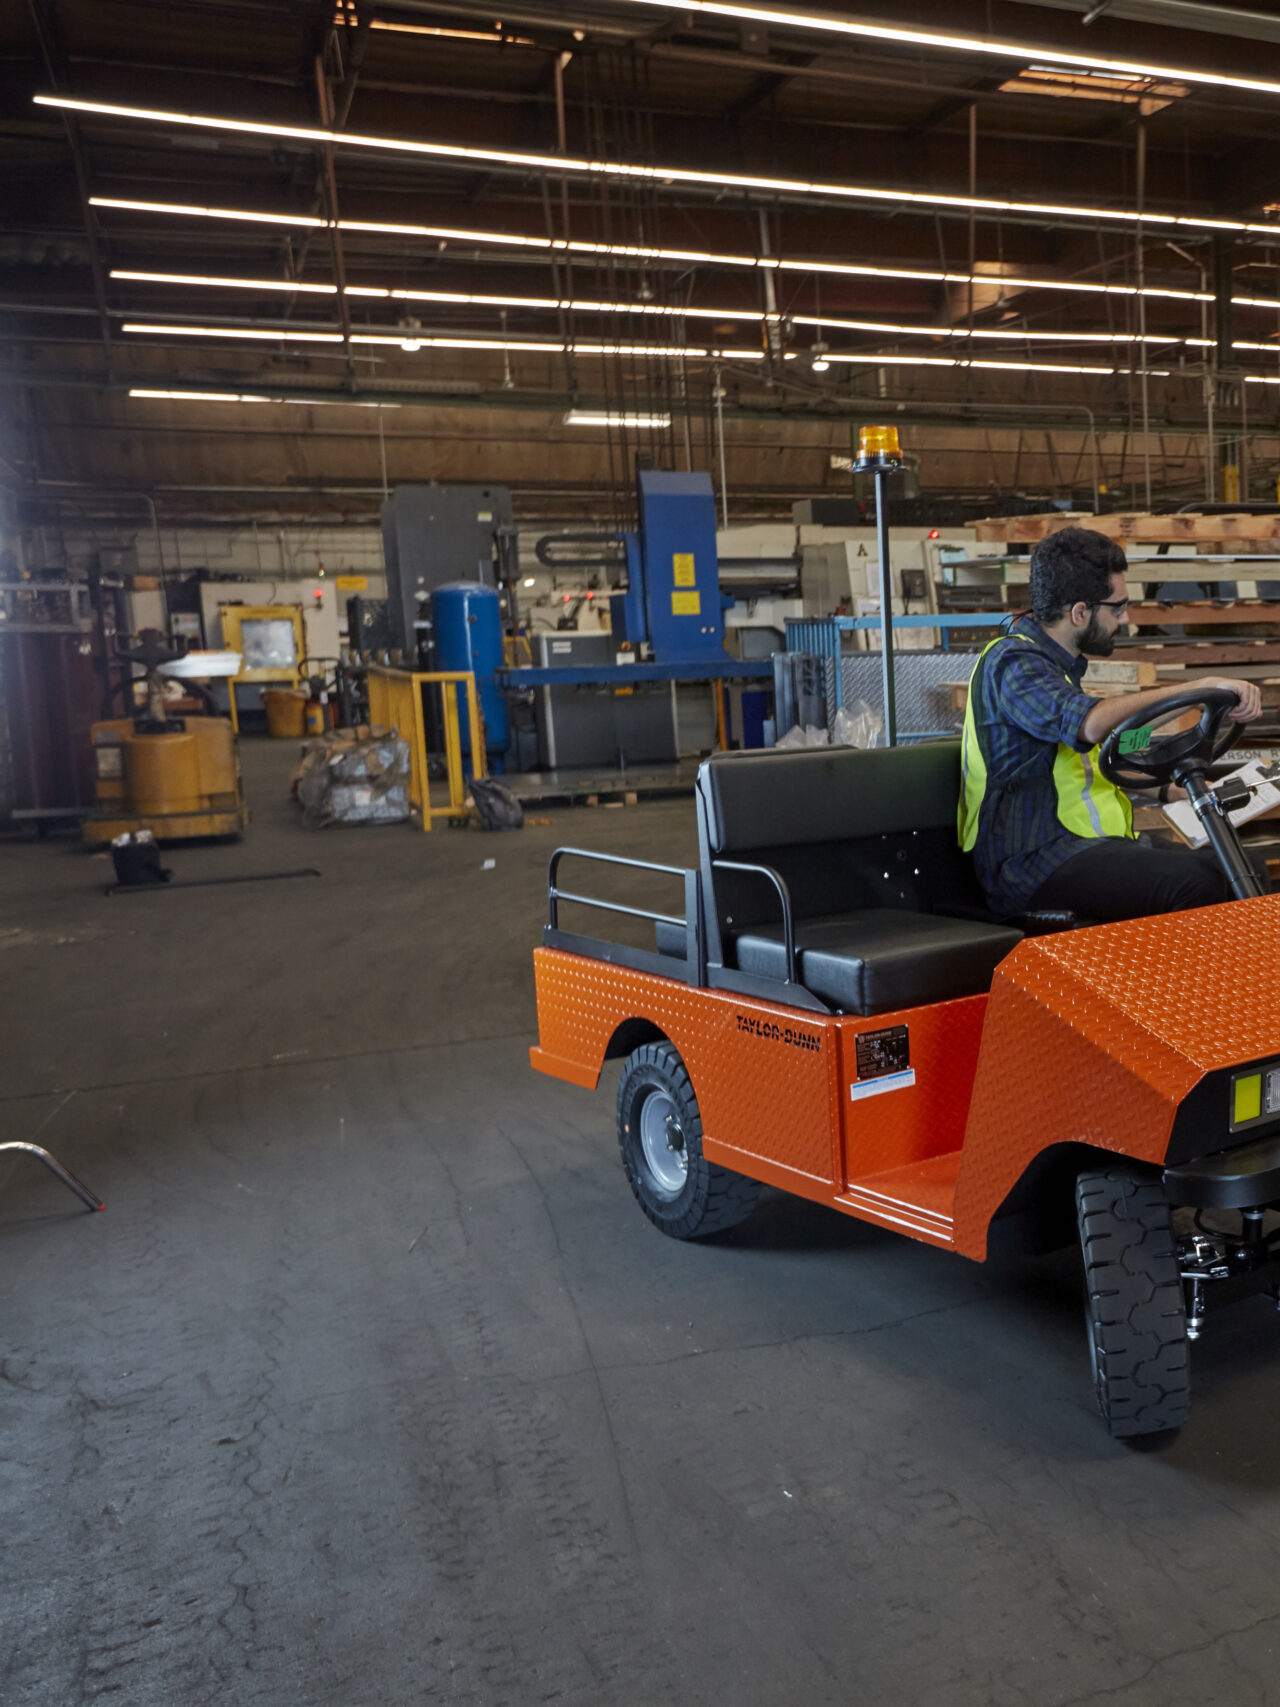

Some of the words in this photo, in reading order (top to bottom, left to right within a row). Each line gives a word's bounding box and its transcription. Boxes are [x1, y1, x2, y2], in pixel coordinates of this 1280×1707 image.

[857, 543, 868, 557] A
[1220, 750, 1262, 761] ERSON
[736, 1015, 821, 1052] TAYLOR-DUNN
